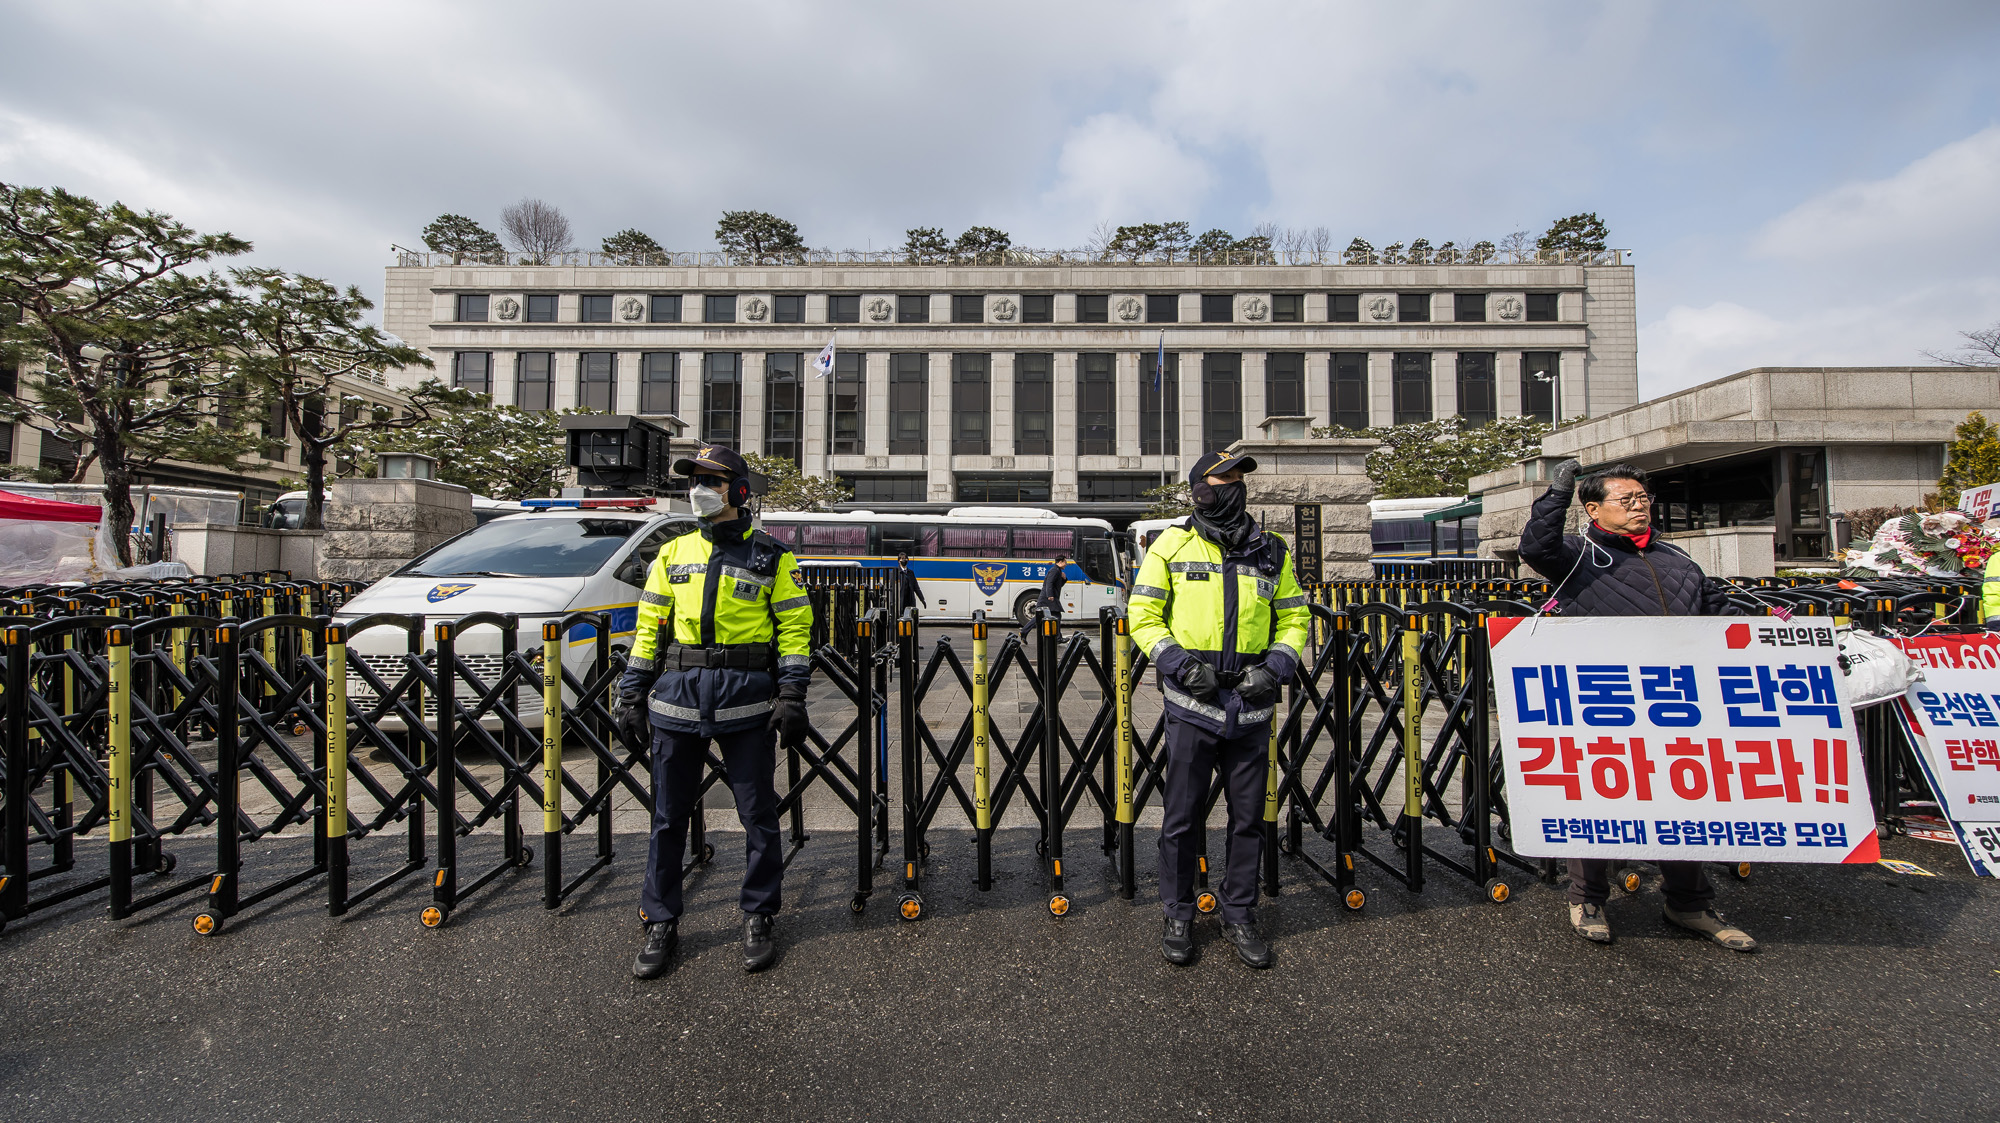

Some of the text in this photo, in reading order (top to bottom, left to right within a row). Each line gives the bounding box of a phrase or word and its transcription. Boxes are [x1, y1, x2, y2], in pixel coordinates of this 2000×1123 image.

[1300, 506, 1317, 587] 헌법재판소
[738, 581, 759, 595] 경찰
[1022, 566, 1047, 577] 경찰
[1758, 627, 1833, 647] 국민의힘
[1960, 643, 2000, 669] 60
[1512, 664, 1842, 728] 대통령 탄핵
[1917, 691, 2000, 727] 윤석열
[326, 678, 337, 817] POLICE LINE
[544, 674, 557, 813] 질서유지선
[974, 673, 987, 810] 질서유지선
[1120, 669, 1131, 804] POLICE LINE
[1411, 664, 1421, 798] POLICE LINE
[1944, 739, 2000, 771] 탄핵
[1976, 795, 2000, 804] 국민의힘
[1541, 818, 1849, 848] 탄핵반대 당협위원장 모임
[1973, 827, 2000, 863] 헌
